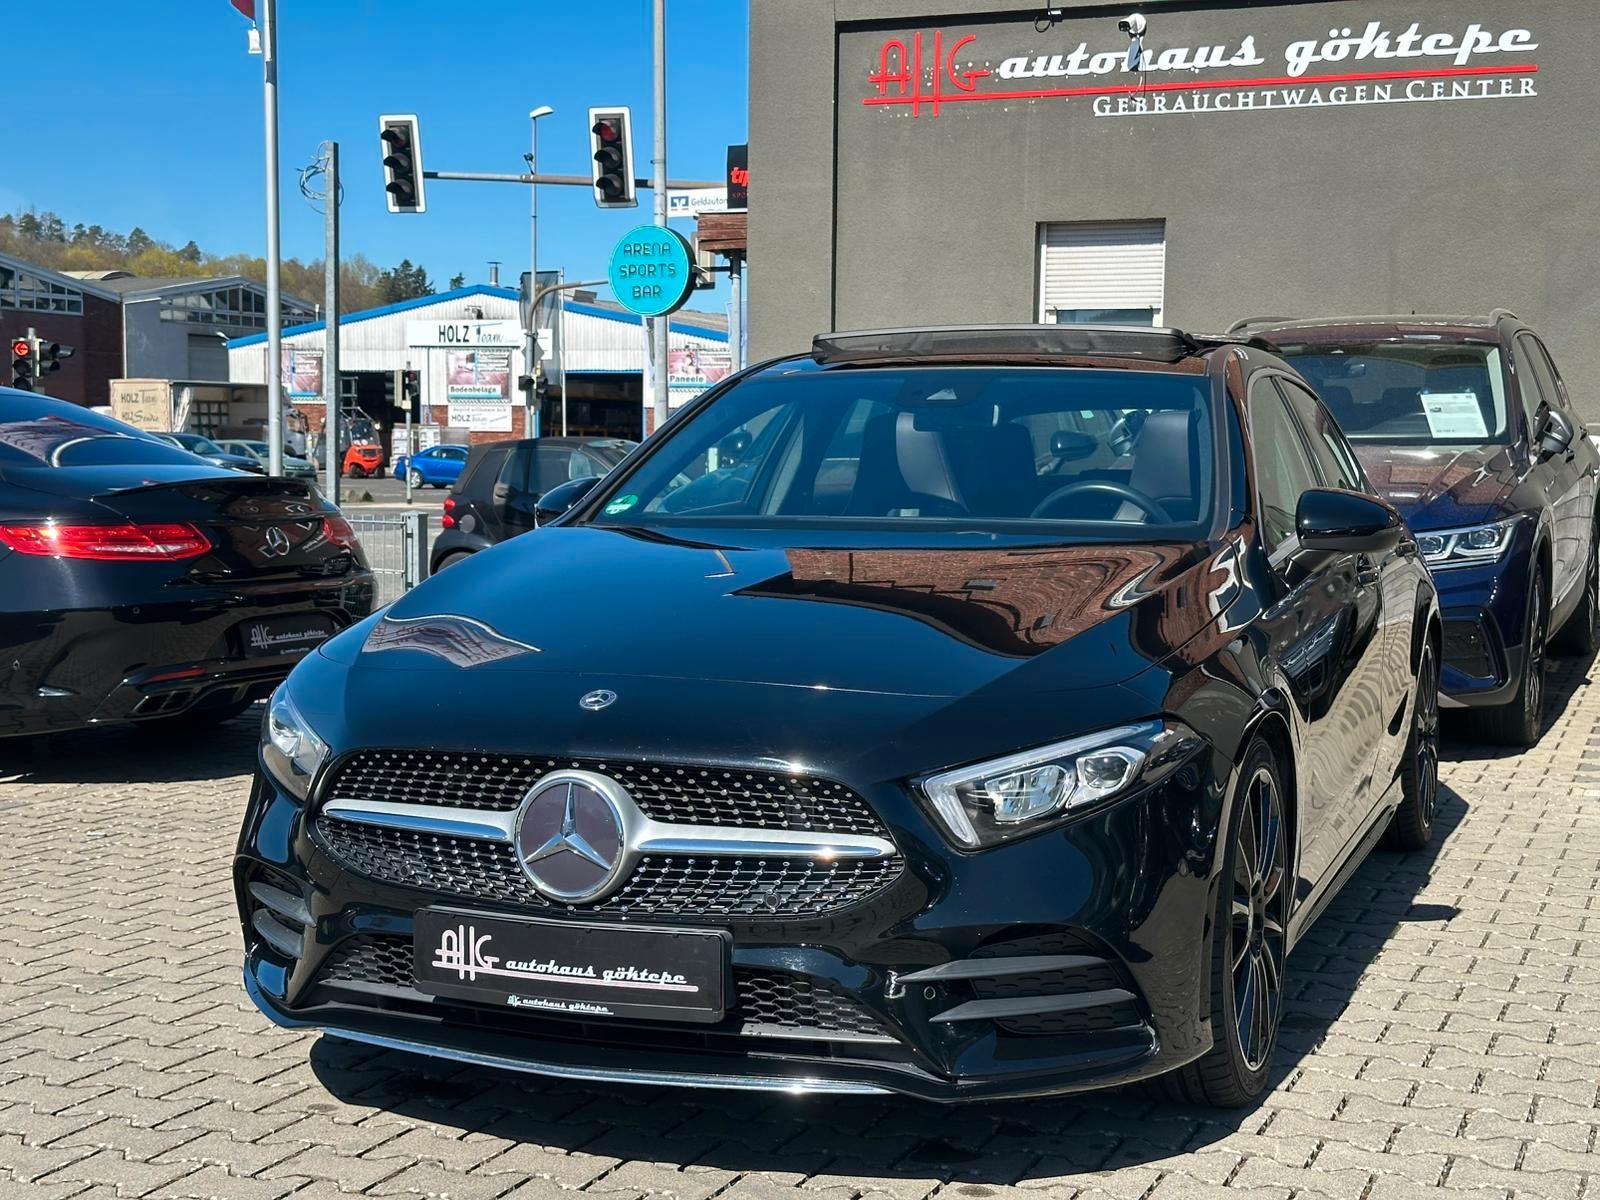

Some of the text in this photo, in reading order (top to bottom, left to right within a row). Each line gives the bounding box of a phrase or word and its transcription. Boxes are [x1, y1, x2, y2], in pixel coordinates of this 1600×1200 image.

[1284, 20, 1540, 78] göktepe
[1405, 77, 1538, 101] CENTER
[623, 242, 672, 256] ARENA
[619, 263, 676, 278] SPORTS
[632, 285, 662, 299] BAR
[438, 321, 504, 343] HOLZ Team
[669, 375, 704, 383] Paneele
[451, 414, 471, 422] HOLZ
[505, 959, 597, 978] autohaus
[602, 966, 688, 985] göktepe
[522, 998, 567, 1009] autohaus
[568, 1001, 609, 1012] göktepe
